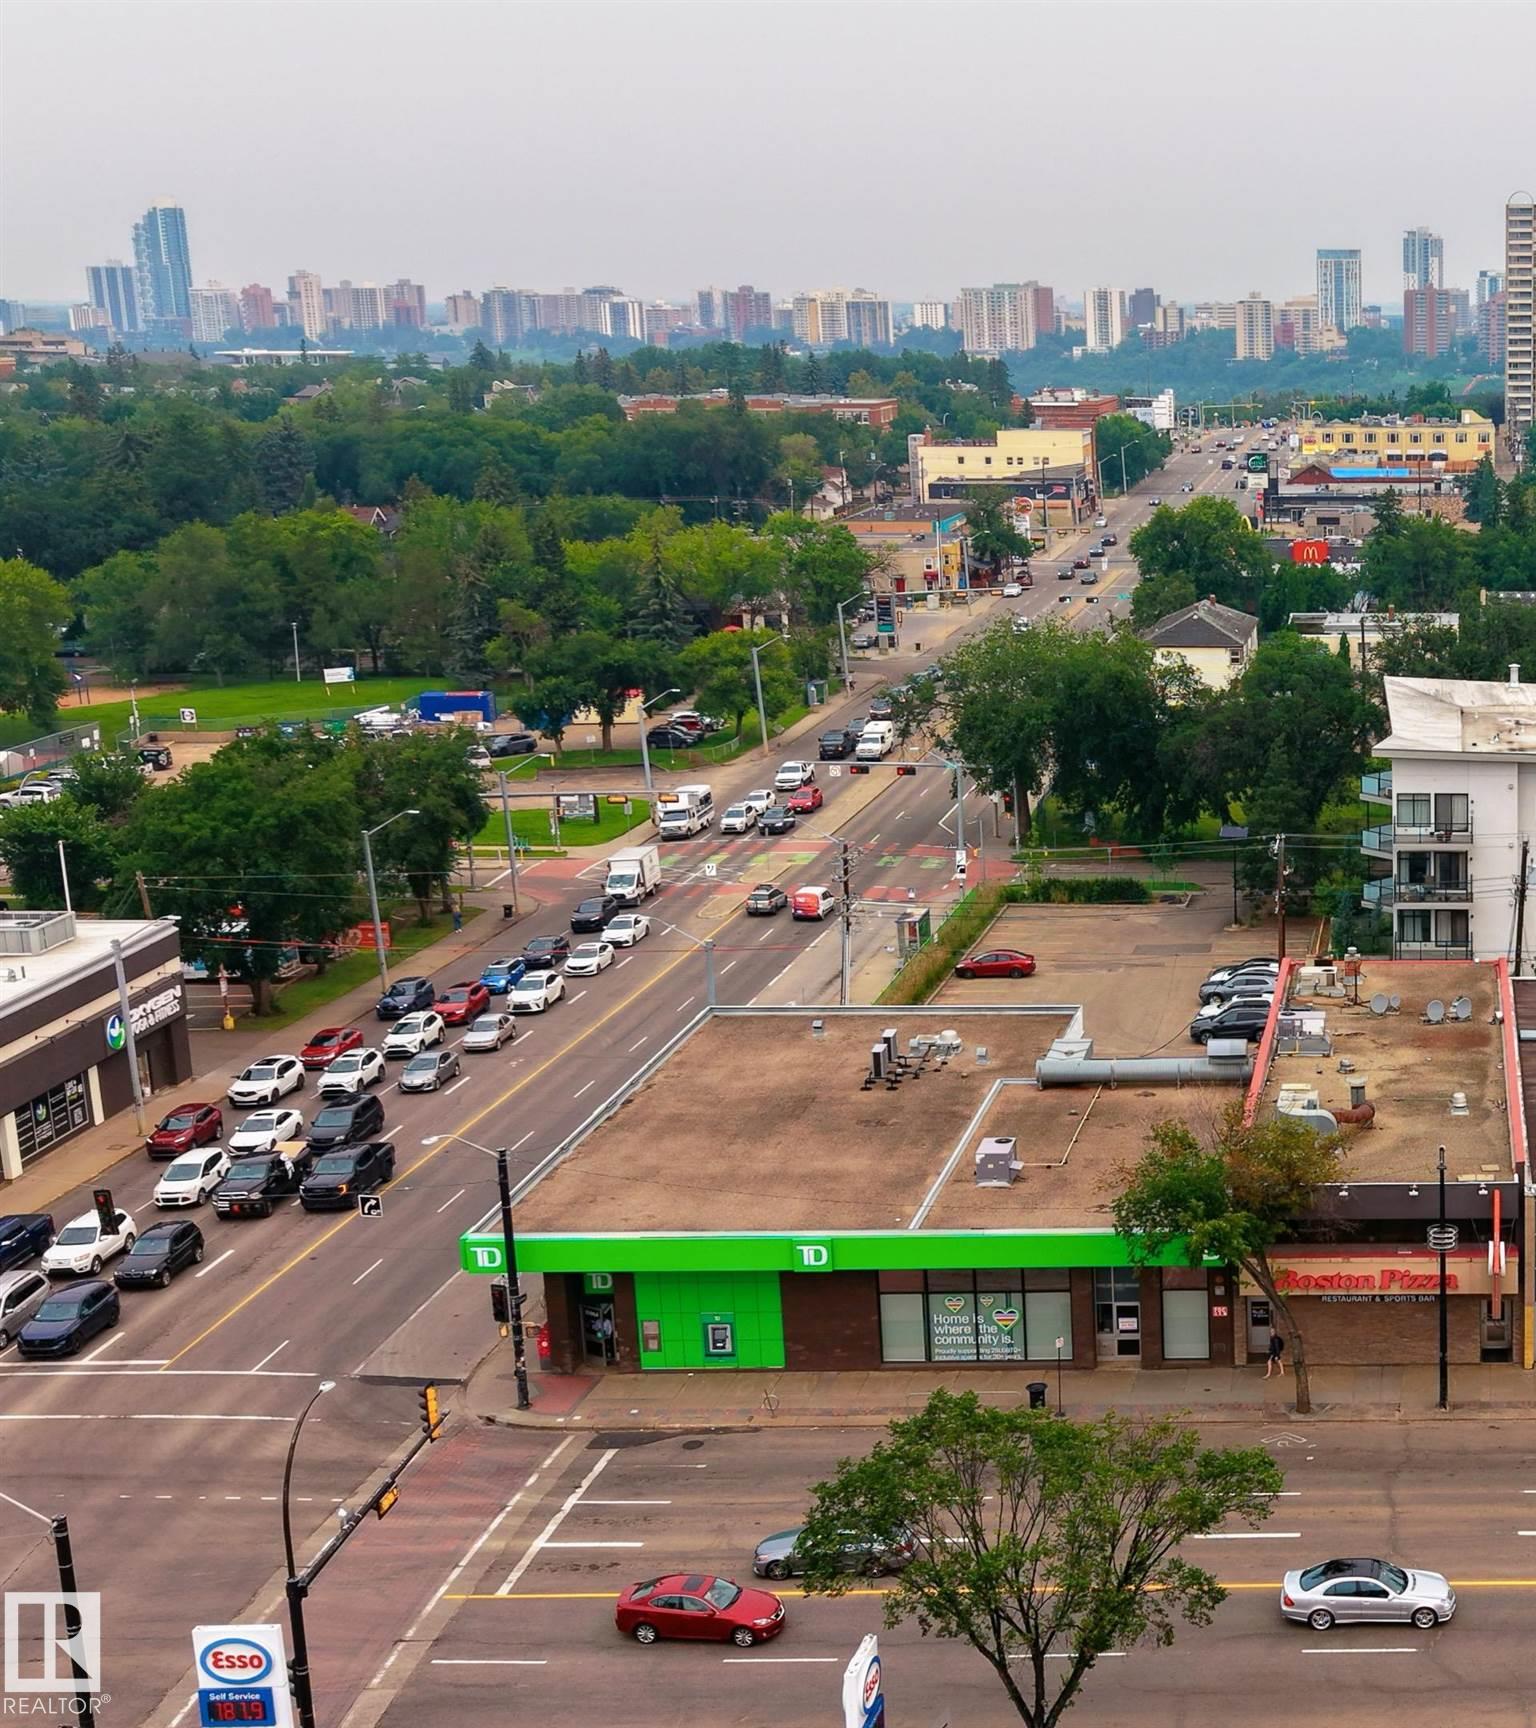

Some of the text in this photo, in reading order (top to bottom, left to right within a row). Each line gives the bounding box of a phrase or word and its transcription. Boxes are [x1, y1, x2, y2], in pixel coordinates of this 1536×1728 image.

[154, 999, 181, 1023] FITNESS
[470, 1247, 502, 1268] TD
[796, 1245, 828, 1266] TD
[586, 1272, 613, 1289] TD
[1274, 1268, 1458, 1290] Boston Pizza
[1321, 1295, 1436, 1303] RESTAURANT & SPORTS BAR
[934, 1314, 969, 1324] Home
[934, 1323, 998, 1334] where the
[934, 1334, 1014, 1346] community is.
[211, 1650, 264, 1669] Esso
[208, 1692, 261, 1701] Self Service
